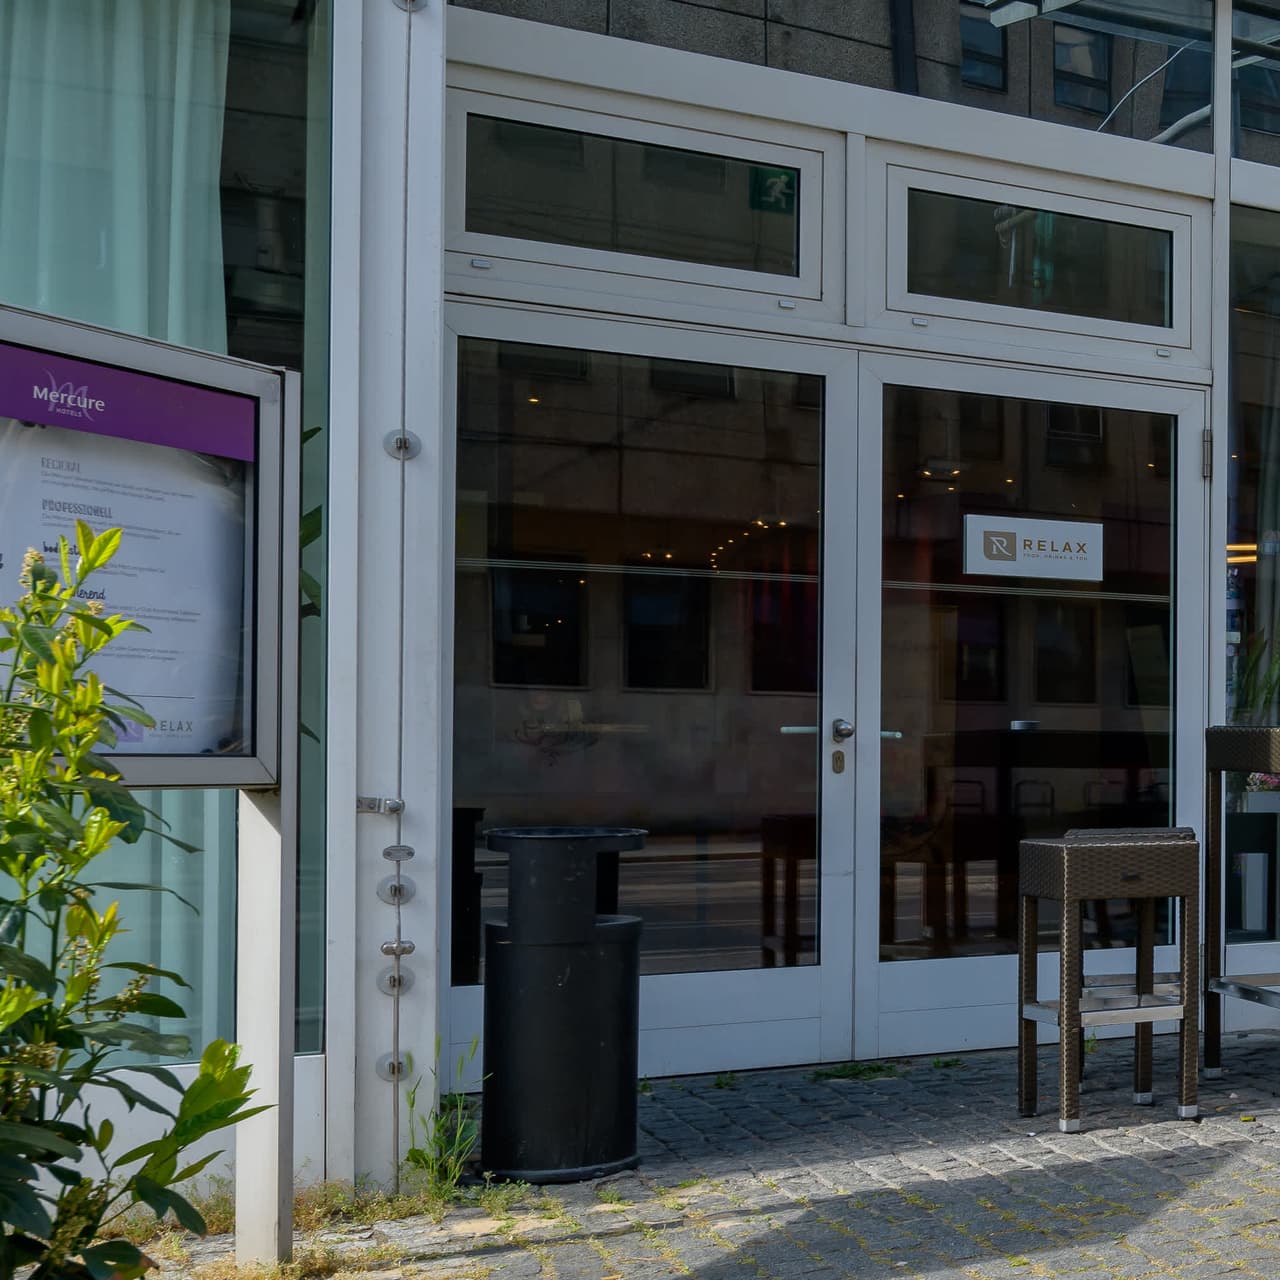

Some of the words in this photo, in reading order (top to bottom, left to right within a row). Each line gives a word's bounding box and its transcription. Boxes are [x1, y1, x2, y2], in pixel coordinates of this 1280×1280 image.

[32, 385, 105, 412] Mercure
[1023, 539, 1088, 553] RELAX
[151, 719, 193, 733] ELAX
